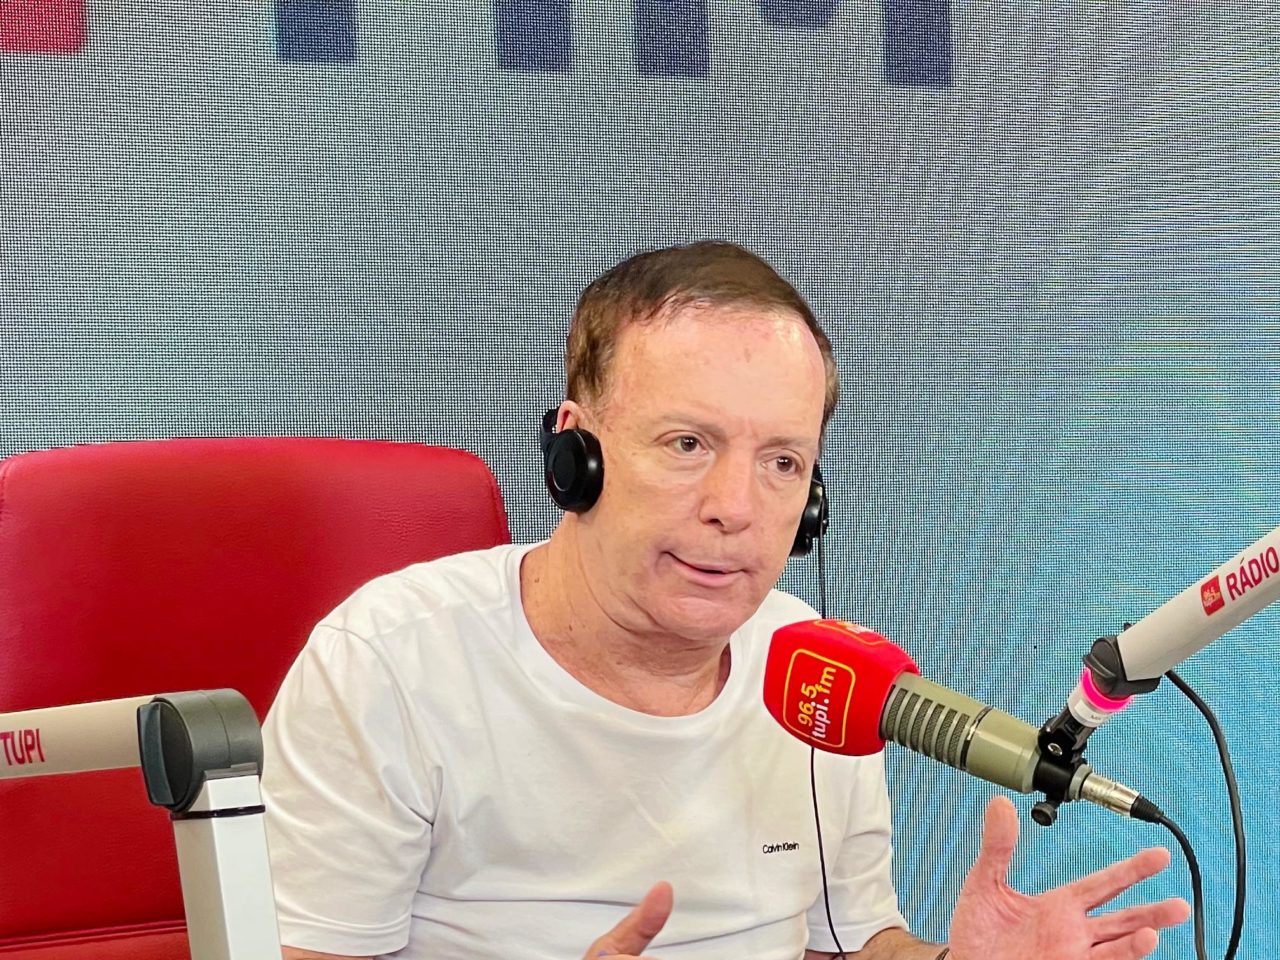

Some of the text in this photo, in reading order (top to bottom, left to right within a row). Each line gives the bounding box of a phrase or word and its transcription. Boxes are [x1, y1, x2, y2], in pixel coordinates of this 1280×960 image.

[1226, 547, 1280, 601] RÁDIO
[0, 728, 45, 766] TUPI
[762, 841, 800, 854] Calvin Klein
